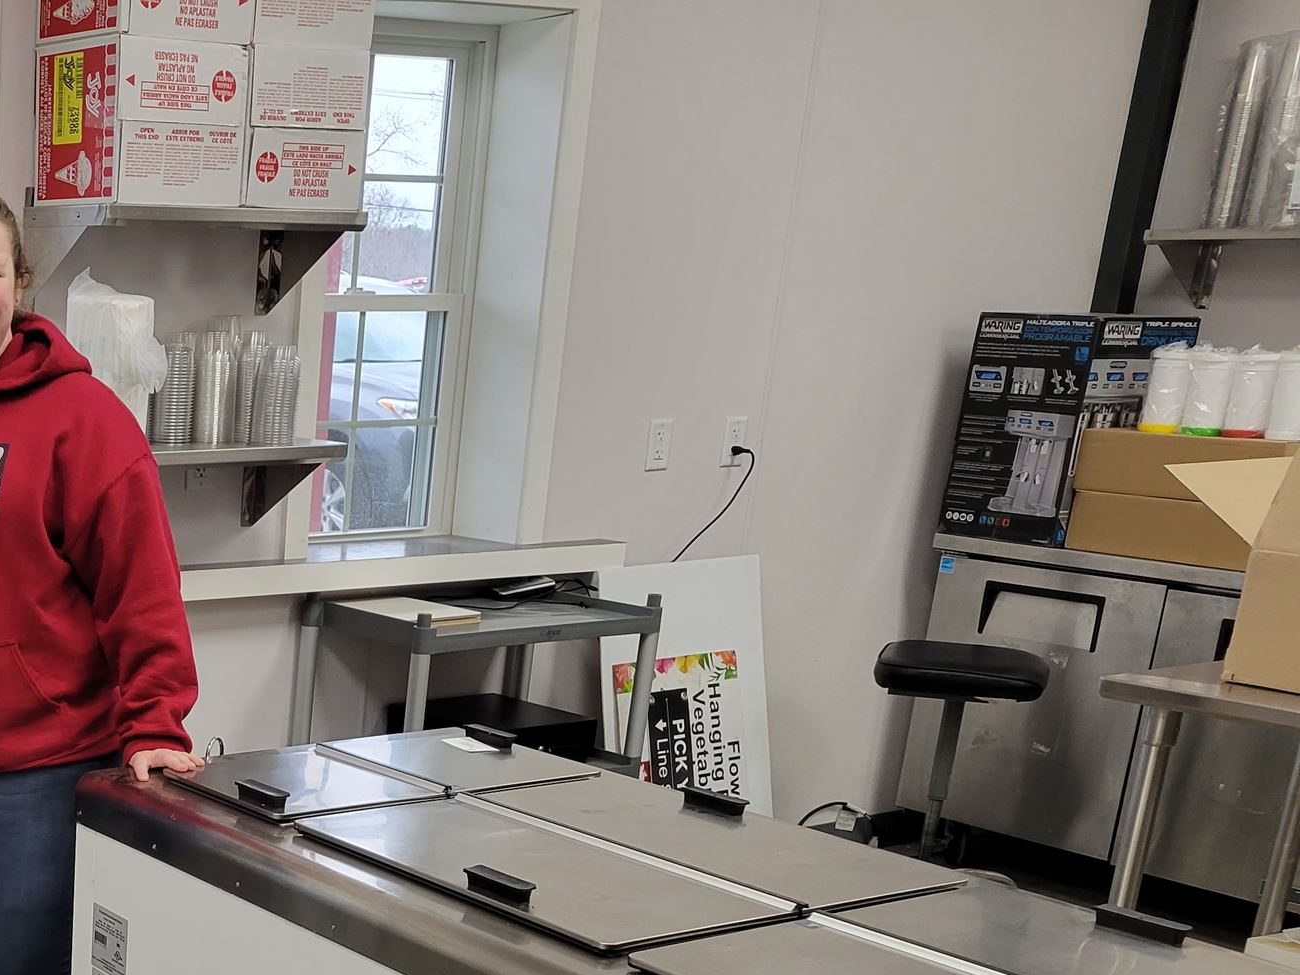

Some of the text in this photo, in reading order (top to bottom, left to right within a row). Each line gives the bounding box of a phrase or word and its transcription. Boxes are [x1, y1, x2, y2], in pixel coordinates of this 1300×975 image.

[180, 6, 216, 17] NO APLASTAR
[175, 17, 183, 26] NE
[184, 18, 194, 27] PAS
[180, 53, 190, 62] PAS
[190, 54, 198, 63] NE
[158, 63, 195, 73] NO APLASTAR
[156, 73, 196, 83] DO NOT CRUSH
[293, 169, 329, 178] DO NOT CRUSH
[302, 179, 327, 187] APLASTAR
[289, 188, 296, 196] NE
[297, 189, 306, 197] PAS
[984, 320, 1021, 332] WARING
[1107, 325, 1140, 336] WARING
[707, 683, 725, 781] Hanging
[692, 689, 711, 791] Vegetab
[672, 718, 688, 773] PICK
[656, 738, 669, 778] Line
